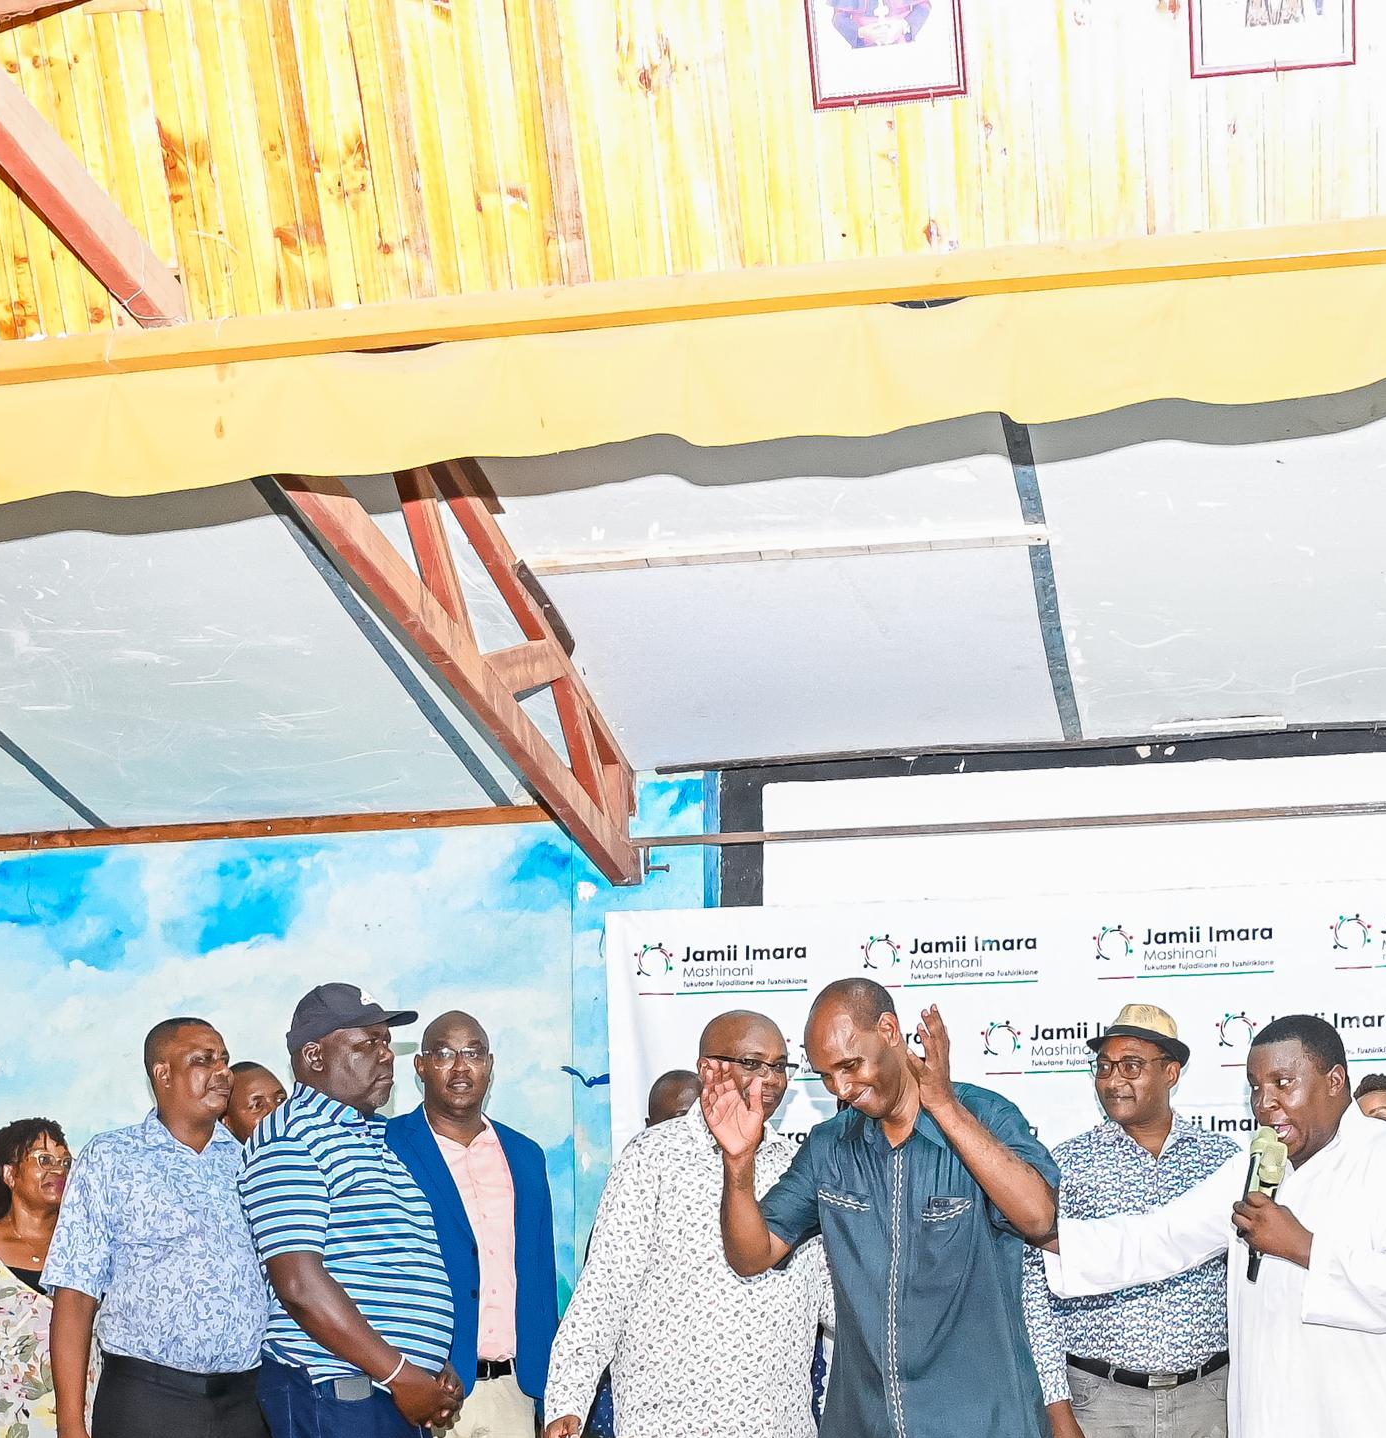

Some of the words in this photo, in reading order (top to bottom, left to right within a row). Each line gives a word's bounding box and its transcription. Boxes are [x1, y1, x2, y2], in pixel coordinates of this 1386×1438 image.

[1142, 926, 1200, 945] Jamii
[1209, 926, 1273, 942] Imara
[909, 935, 966, 954] Jamii
[974, 936, 1037, 952] Imara
[682, 945, 737, 962] Jamii
[746, 945, 807, 960] Imara
[1143, 946, 1217, 961] Mashinani
[910, 955, 983, 970] Mashinani
[683, 964, 753, 978] Mashinani
[1030, 1022, 1088, 1040] Jamii
[1031, 1043, 1091, 1056] Mashina
